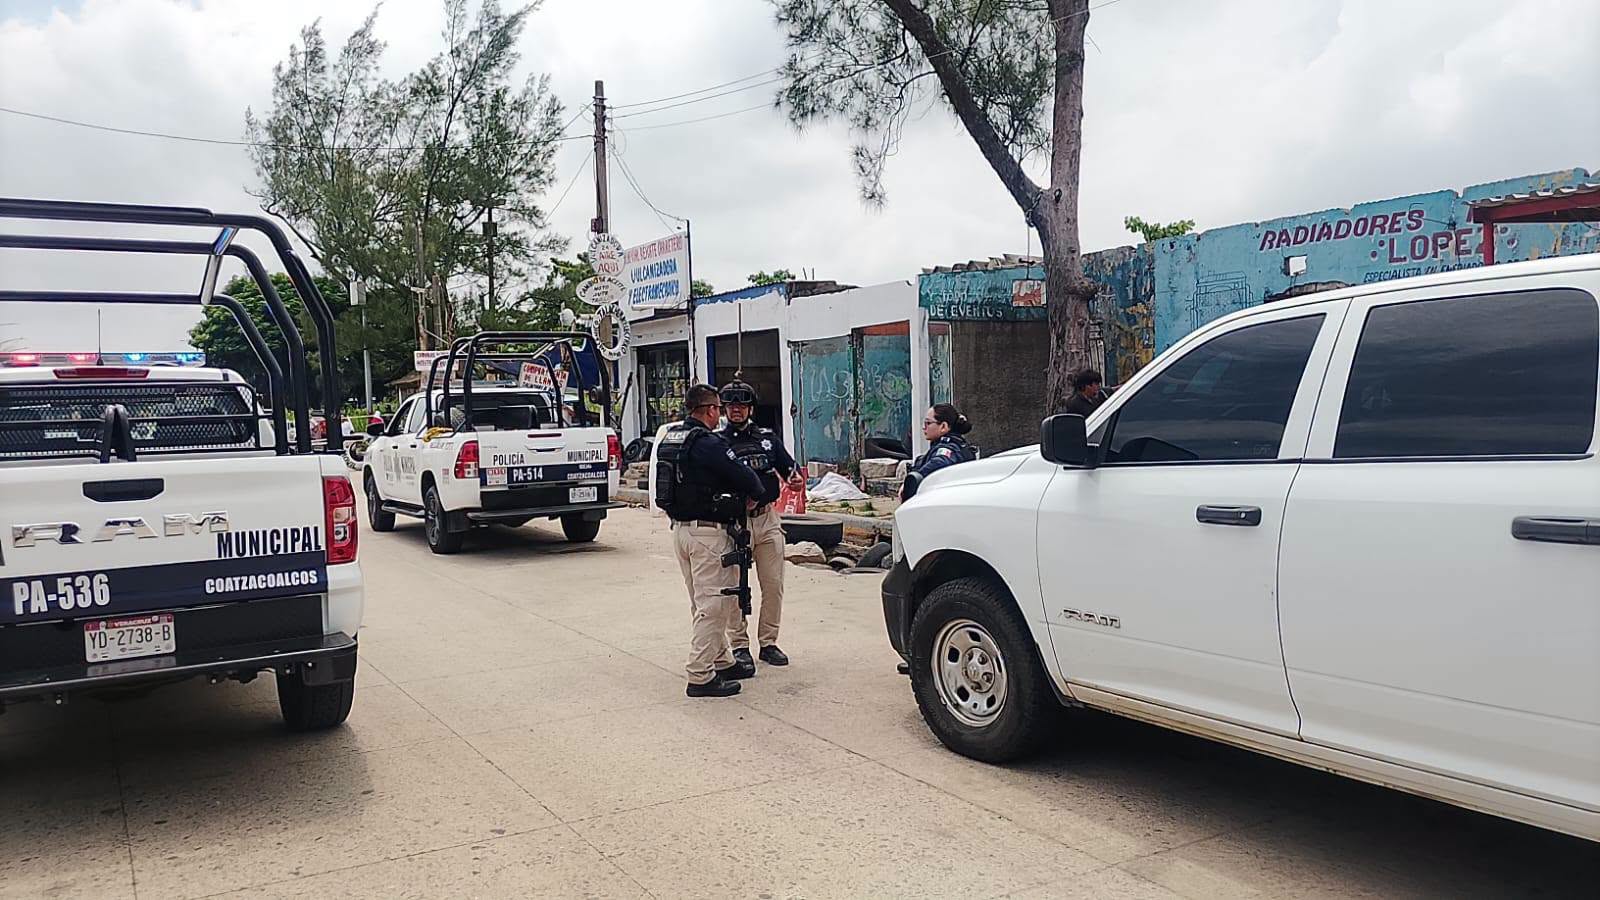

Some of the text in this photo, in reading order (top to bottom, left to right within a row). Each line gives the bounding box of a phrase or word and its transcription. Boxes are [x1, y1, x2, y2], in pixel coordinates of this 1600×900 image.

[1258, 209, 1425, 251] RADIADORES
[599, 251, 616, 260] AIRE
[598, 262, 619, 273] AQUI
[1363, 267, 1422, 283] ESPECIALISTA
[607, 277, 627, 291] ACEITE
[534, 376, 563, 388] LLANS
[567, 450, 603, 461] MUNICIPAL
[513, 467, 543, 481] PA-514
[567, 471, 606, 480] COATZACOALCOS
[11, 510, 230, 549] RAM
[217, 525, 322, 558] MUNICIPAL
[12, 569, 318, 615] PA-536 COATZACOALCOS
[1062, 608, 1121, 629] RAM
[89, 624, 171, 650] YD-2738-B
